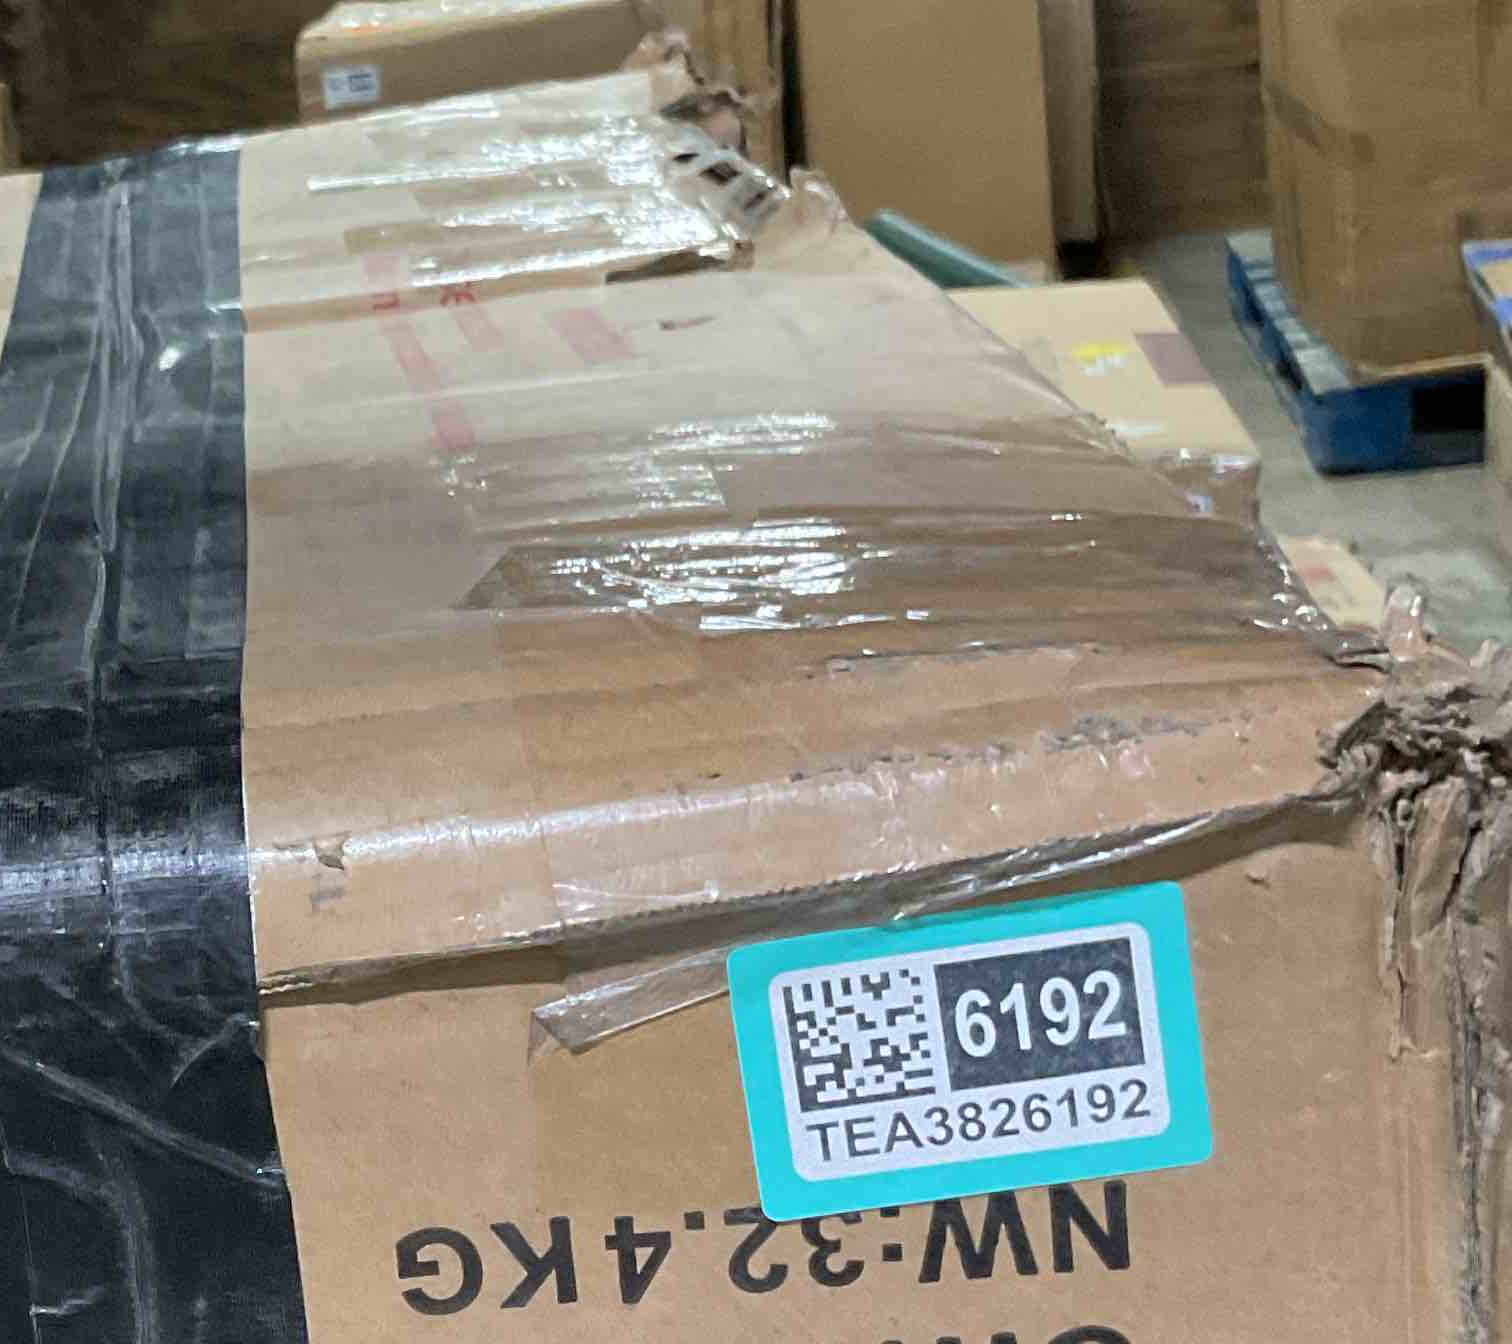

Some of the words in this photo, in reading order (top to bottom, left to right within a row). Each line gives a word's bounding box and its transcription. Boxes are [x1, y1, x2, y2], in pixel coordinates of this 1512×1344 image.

[953, 969, 1127, 1058] 6192
[806, 1077, 1151, 1162] TEA3826192
[394, 1216, 578, 1315] KG
